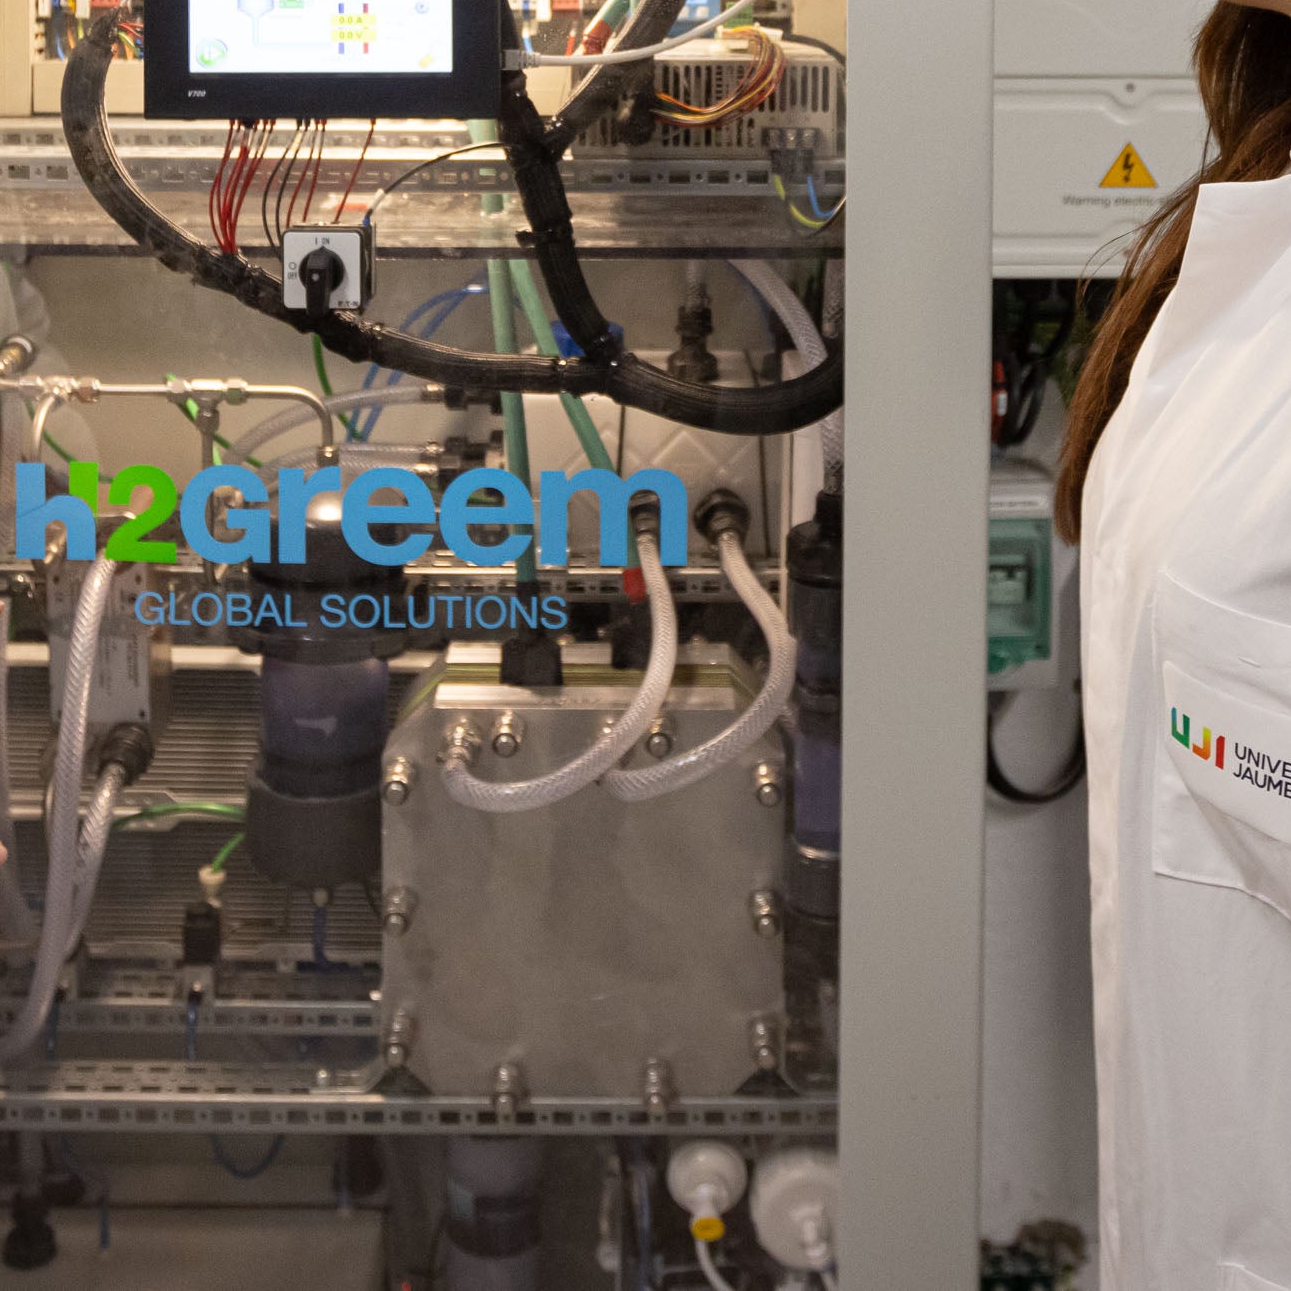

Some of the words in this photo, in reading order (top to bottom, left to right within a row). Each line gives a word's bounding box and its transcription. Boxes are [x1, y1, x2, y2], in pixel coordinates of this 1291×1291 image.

[188, 90, 206, 98] V700
[1062, 195, 1111, 208] Warning
[321, 237, 330, 245] ON
[287, 272, 297, 280] OFF
[134, 591, 307, 627] GLOBAL
[319, 595, 568, 630] SOLUTIONS
[1171, 707, 1225, 770] UJI
